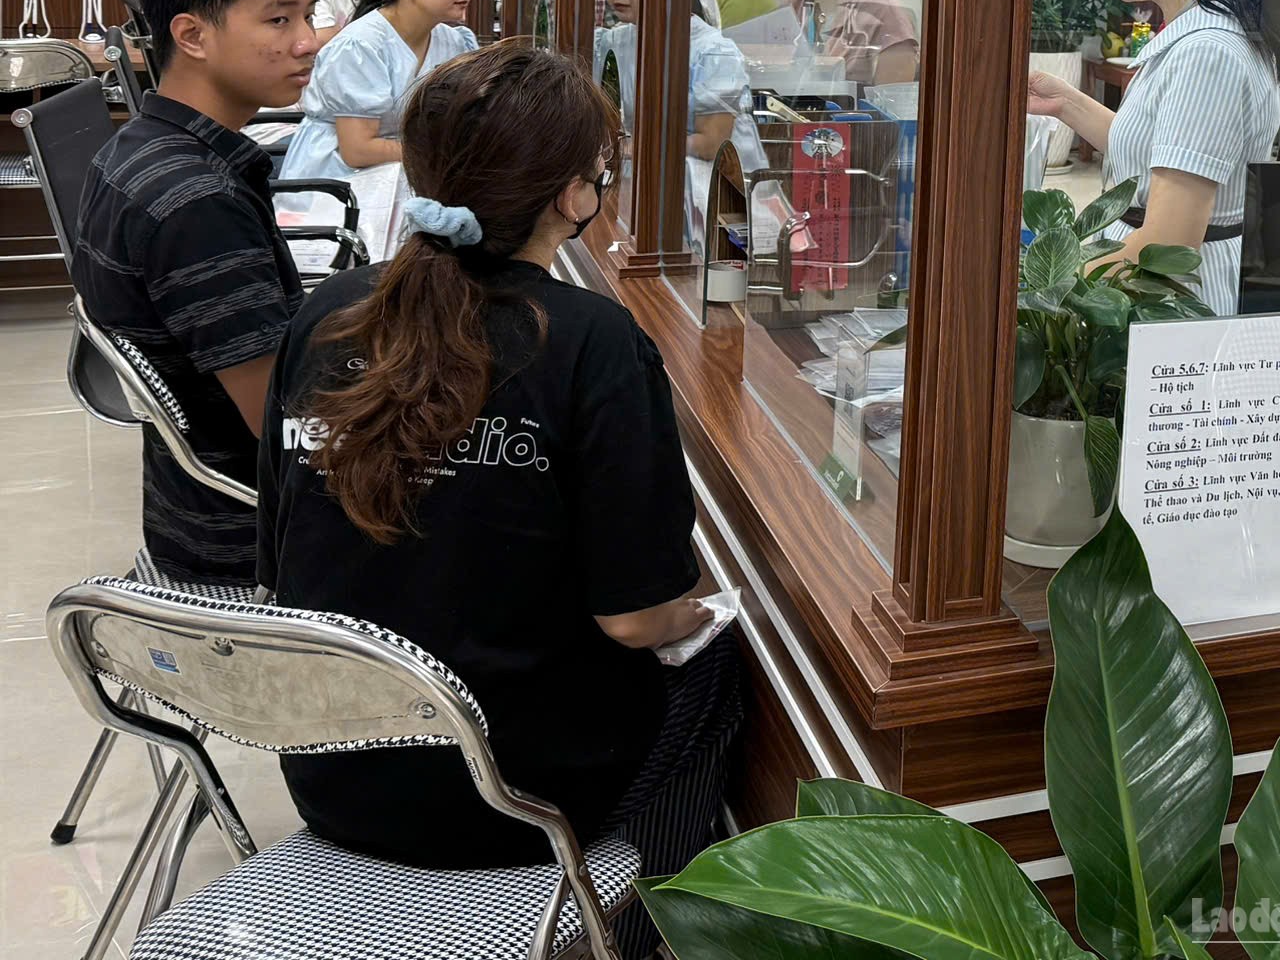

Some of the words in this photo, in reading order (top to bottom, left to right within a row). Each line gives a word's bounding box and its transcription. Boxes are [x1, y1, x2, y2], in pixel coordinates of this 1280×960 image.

[1213, 361, 1235, 373] Lĩnh
[1239, 362, 1256, 373] vực
[1259, 359, 1273, 369] Tư
[1159, 382, 1174, 394] Hộ
[1176, 381, 1195, 393] tịch
[1180, 397, 1193, 412] số
[1218, 398, 1241, 410] Lĩnh
[1248, 398, 1265, 409] vực
[1148, 420, 1184, 433] thương
[1192, 417, 1209, 428] Tài
[1211, 415, 1238, 427] chính
[1246, 413, 1266, 426] Xây
[1174, 435, 1187, 451] số
[1190, 437, 1201, 450] 2:
[1205, 437, 1228, 449] Lĩnh
[1231, 436, 1249, 447] vực
[1252, 431, 1269, 444] Đất
[1146, 458, 1172, 471] Nông
[1174, 456, 1207, 470] nghiệp
[1217, 452, 1237, 464] Môi
[1239, 450, 1273, 463] trường
[1172, 473, 1184, 489] số
[1188, 476, 1199, 488] 3:
[1203, 474, 1225, 486] Lĩnh
[1229, 473, 1246, 485] vực
[1250, 469, 1269, 481] Văn
[1166, 495, 1188, 506] thao
[1191, 493, 1202, 504] và
[1206, 492, 1220, 502] Du
[1246, 486, 1263, 499] Nội
[1156, 509, 1181, 524] Giáo
[1182, 507, 1200, 521] dục
[1203, 506, 1221, 519] đào
[1223, 507, 1238, 519] tạo
